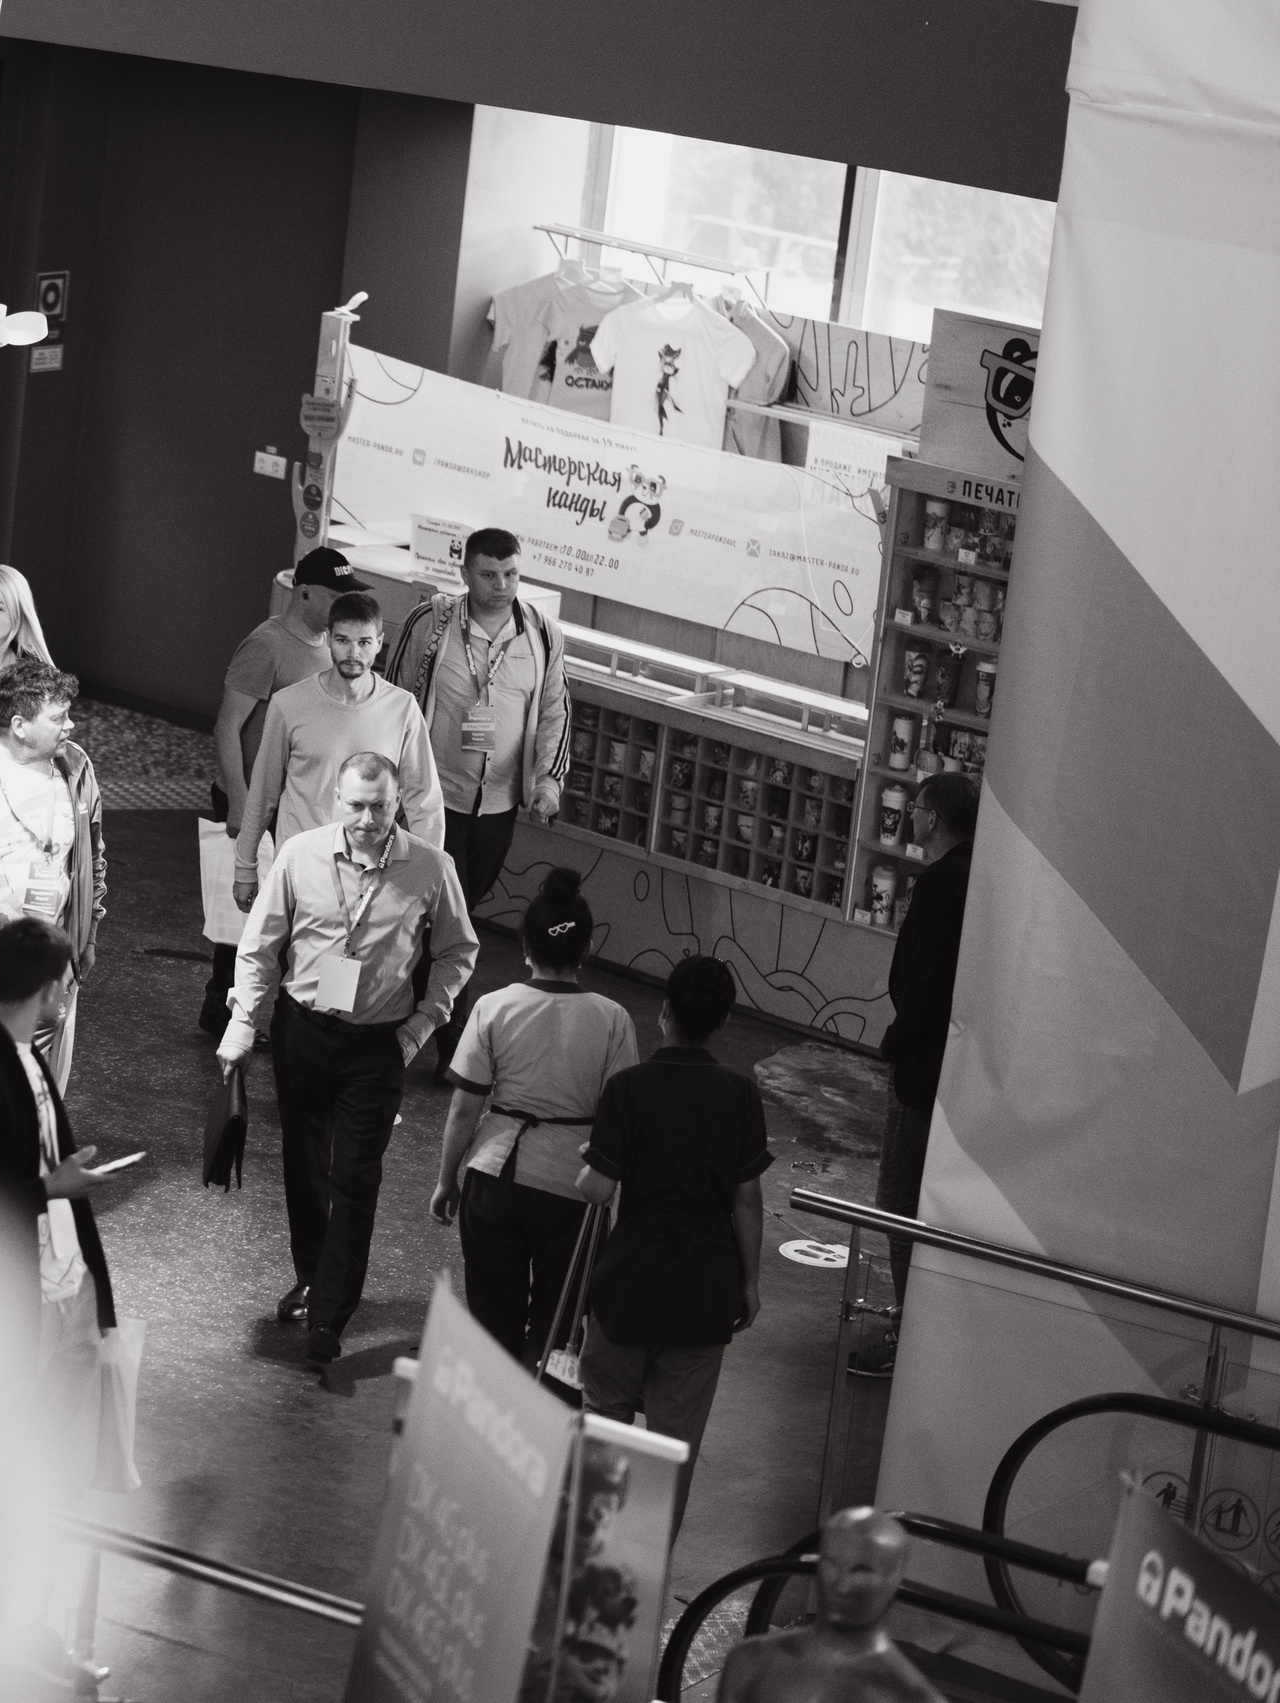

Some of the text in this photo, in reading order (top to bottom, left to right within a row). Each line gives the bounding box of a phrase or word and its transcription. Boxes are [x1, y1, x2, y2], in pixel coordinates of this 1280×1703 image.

[503, 435, 622, 493] Мастерская
[857, 466, 885, 479] ИМЕЮТ
[380, 834, 396, 864] Pandora
